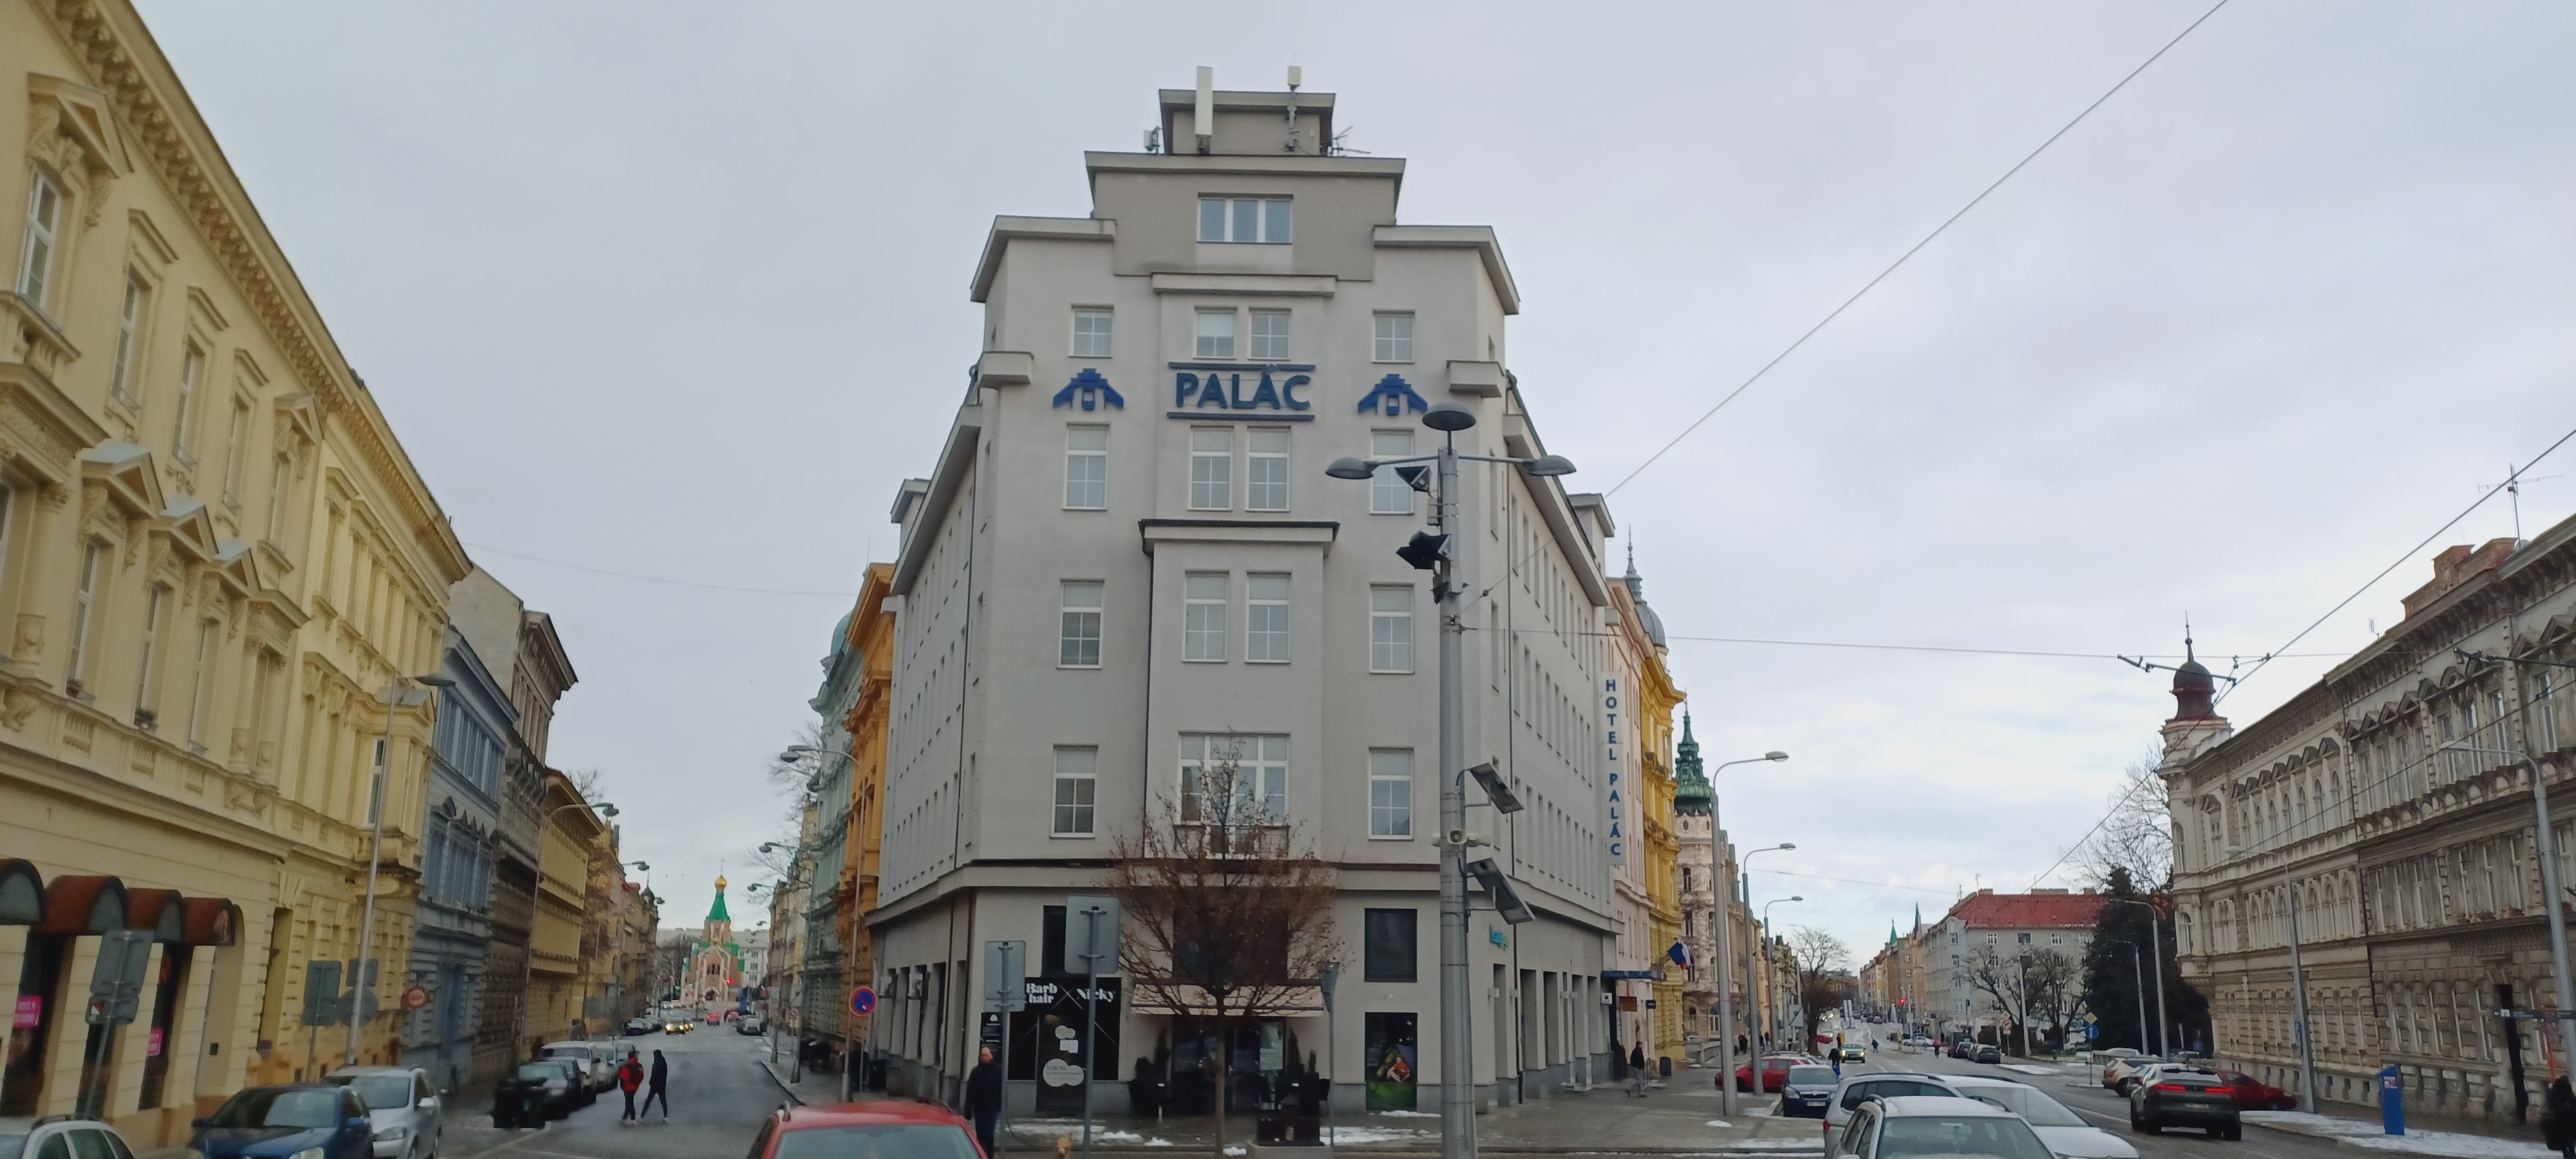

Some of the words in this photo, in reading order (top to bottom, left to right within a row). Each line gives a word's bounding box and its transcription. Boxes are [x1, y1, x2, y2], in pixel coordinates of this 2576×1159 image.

[1176, 364, 1311, 410] PALÁC
[1605, 679, 1617, 760] HOTEL
[1609, 773, 1621, 856] PALÁC
[1026, 983, 1057, 994] Barb
[1028, 994, 1054, 1004] hair
